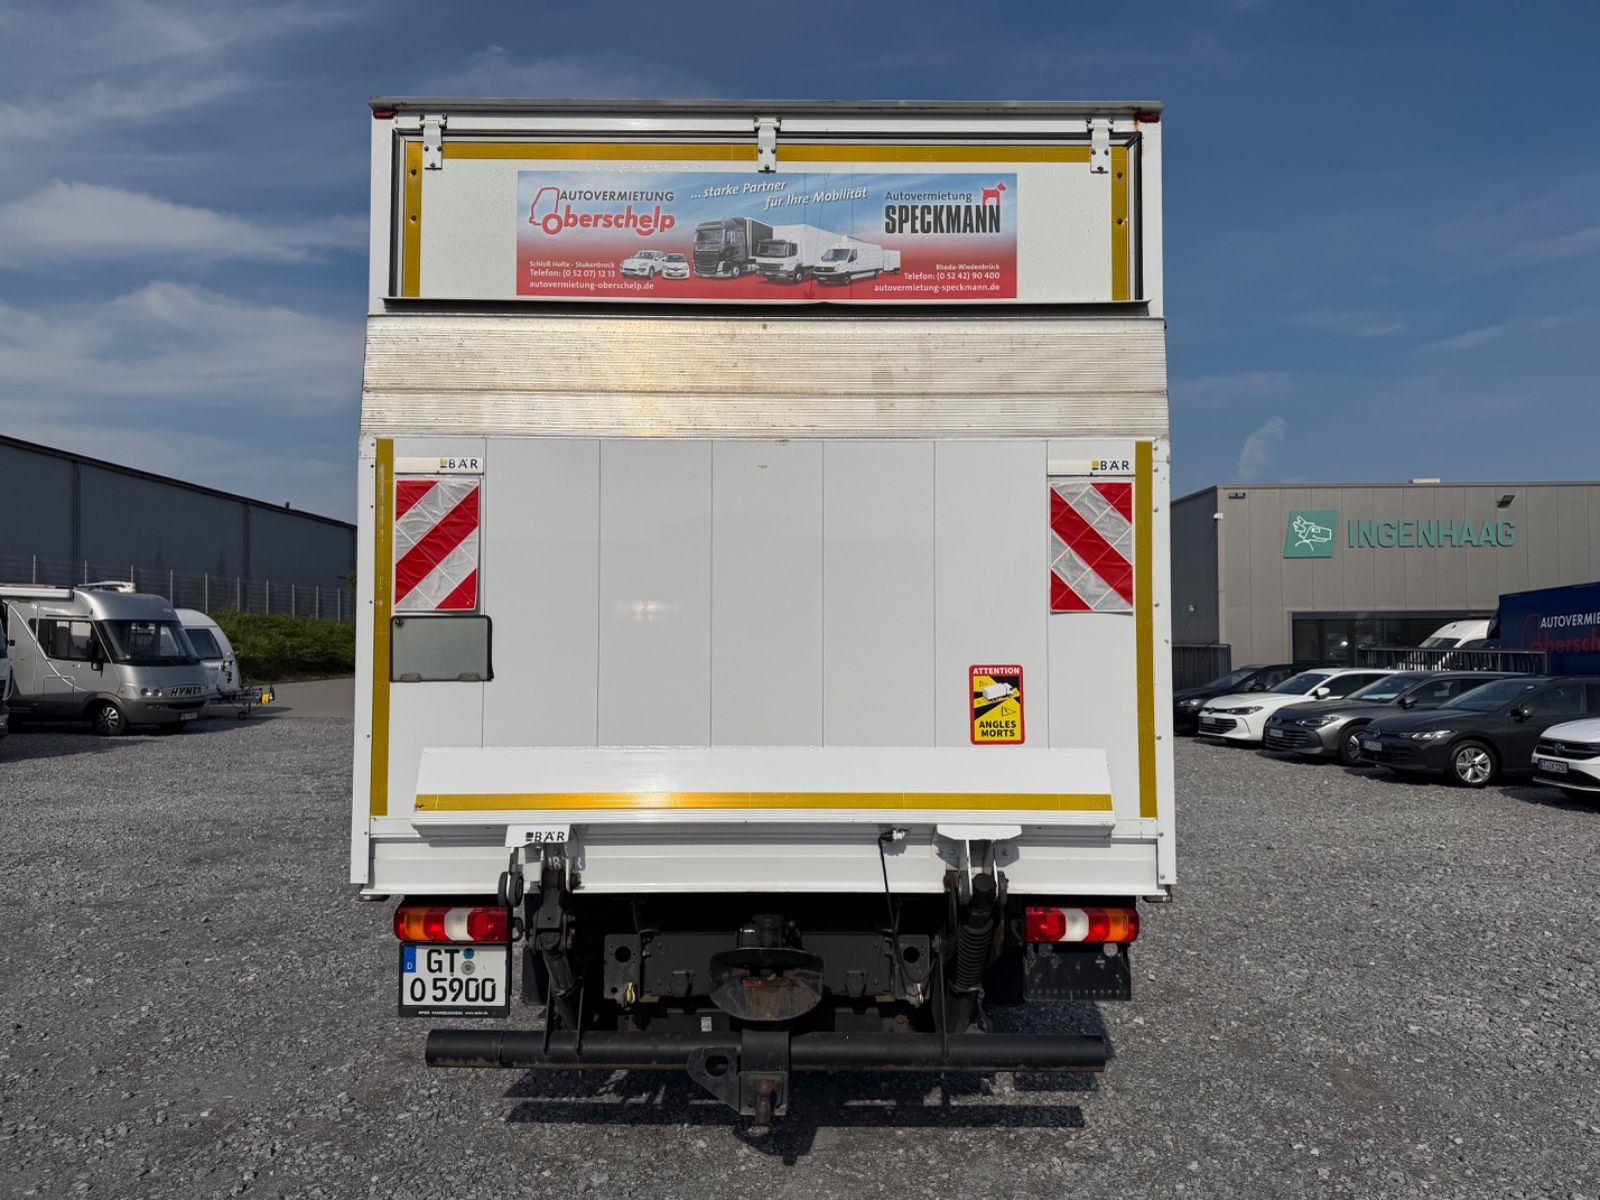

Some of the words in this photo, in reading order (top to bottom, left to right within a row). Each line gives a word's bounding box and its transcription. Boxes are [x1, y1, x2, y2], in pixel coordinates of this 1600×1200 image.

[703, 183, 739, 198] starke
[743, 180, 787, 194] Partner
[560, 190, 674, 202] AUTOVERMIETUNG
[764, 194, 784, 211] für
[787, 194, 809, 207] Ihre
[812, 186, 868, 203] Mobilität
[885, 190, 972, 203] Autovermietung
[884, 204, 1001, 234] SPECKMANN
[529, 269, 561, 277] Telefon:
[562, 269, 571, 278] (0
[572, 269, 581, 277] 52
[583, 269, 596, 278] 07)
[608, 270, 616, 278] 13
[903, 272, 935, 280] Telefon:
[937, 272, 945, 280] (0
[957, 272, 970, 280] 42)
[984, 271, 1000, 279] 400
[529, 281, 655, 291] autovermietung-oberschelp.de
[874, 282, 1000, 294] autovermietung-speckmann.de
[448, 458, 478, 469] BÄR
[1100, 460, 1130, 471] BÄR
[1348, 519, 1517, 548] INGENHAAG
[973, 667, 1020, 675] ATTENTION
[979, 720, 1017, 729] ANGLES
[981, 729, 1015, 737] MORTS
[535, 831, 565, 842] BÄR
[406, 962, 413, 970] D
[426, 949, 460, 973] GT
[432, 977, 496, 1002] 5900
